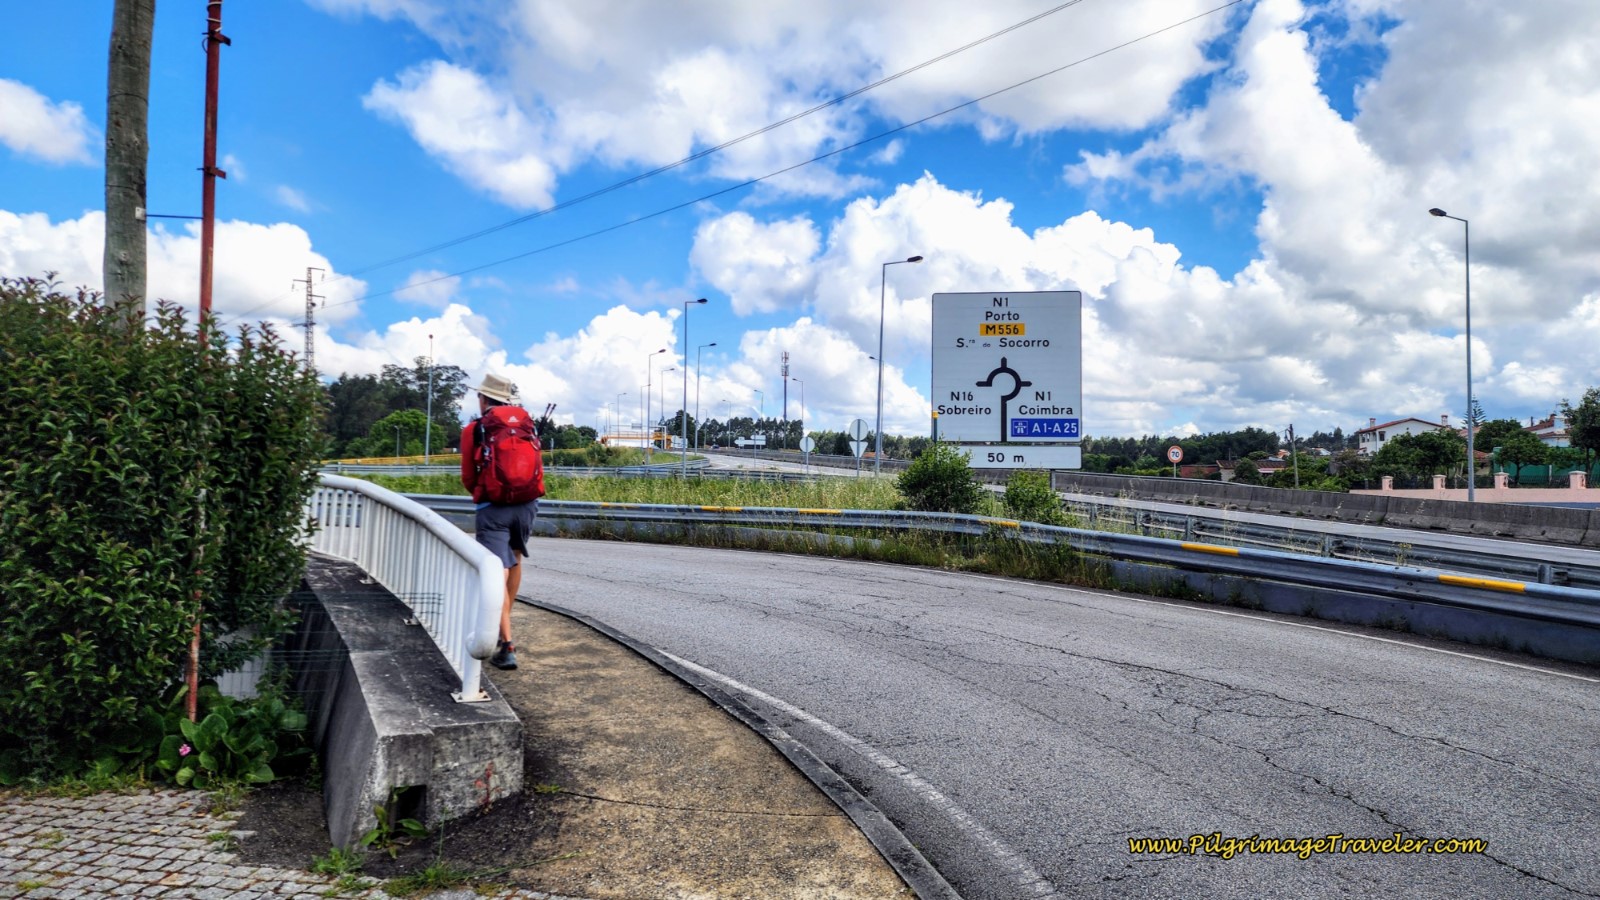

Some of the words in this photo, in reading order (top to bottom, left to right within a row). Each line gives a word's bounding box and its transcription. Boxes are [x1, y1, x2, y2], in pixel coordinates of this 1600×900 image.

[993, 297, 1009, 307] N1
[985, 311, 1020, 321] Porto
[985, 325, 1020, 335] M556
[999, 338, 1050, 348] Socorro
[950, 391, 974, 401] N16
[1035, 391, 1051, 401] N1
[938, 405, 992, 415] Sobreiro
[1018, 405, 1073, 415] Coimbra
[987, 452, 1005, 463] 50
[1013, 455, 1024, 463] m
